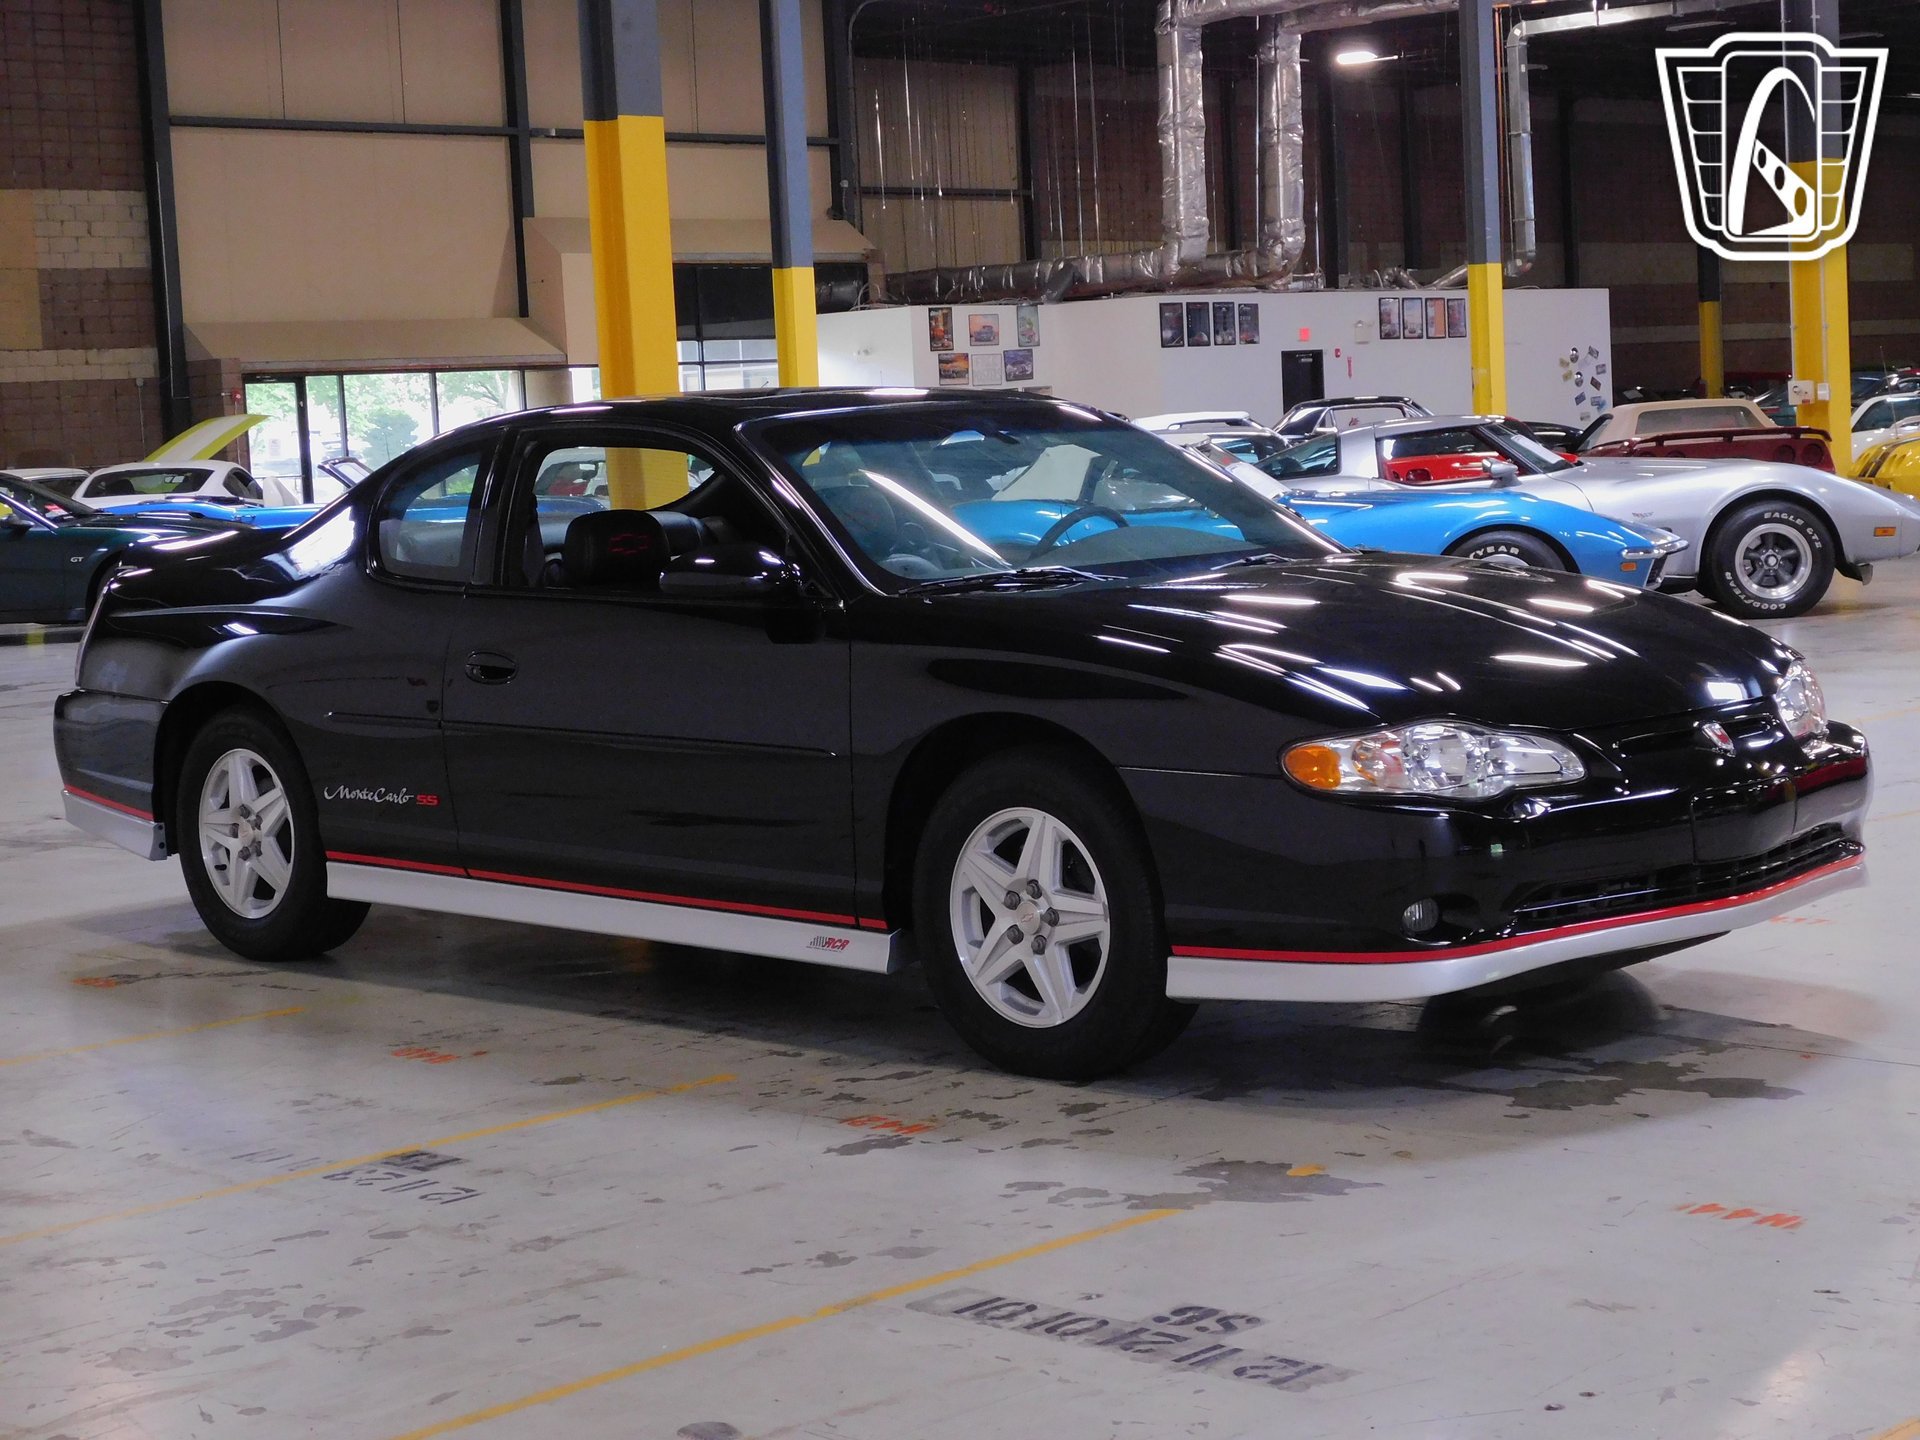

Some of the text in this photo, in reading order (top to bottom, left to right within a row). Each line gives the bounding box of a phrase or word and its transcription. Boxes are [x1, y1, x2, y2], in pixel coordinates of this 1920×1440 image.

[1764, 512, 1804, 525] EAGLE
[1724, 571, 1786, 610] GOODYEAR
[416, 794, 440, 806] SS
